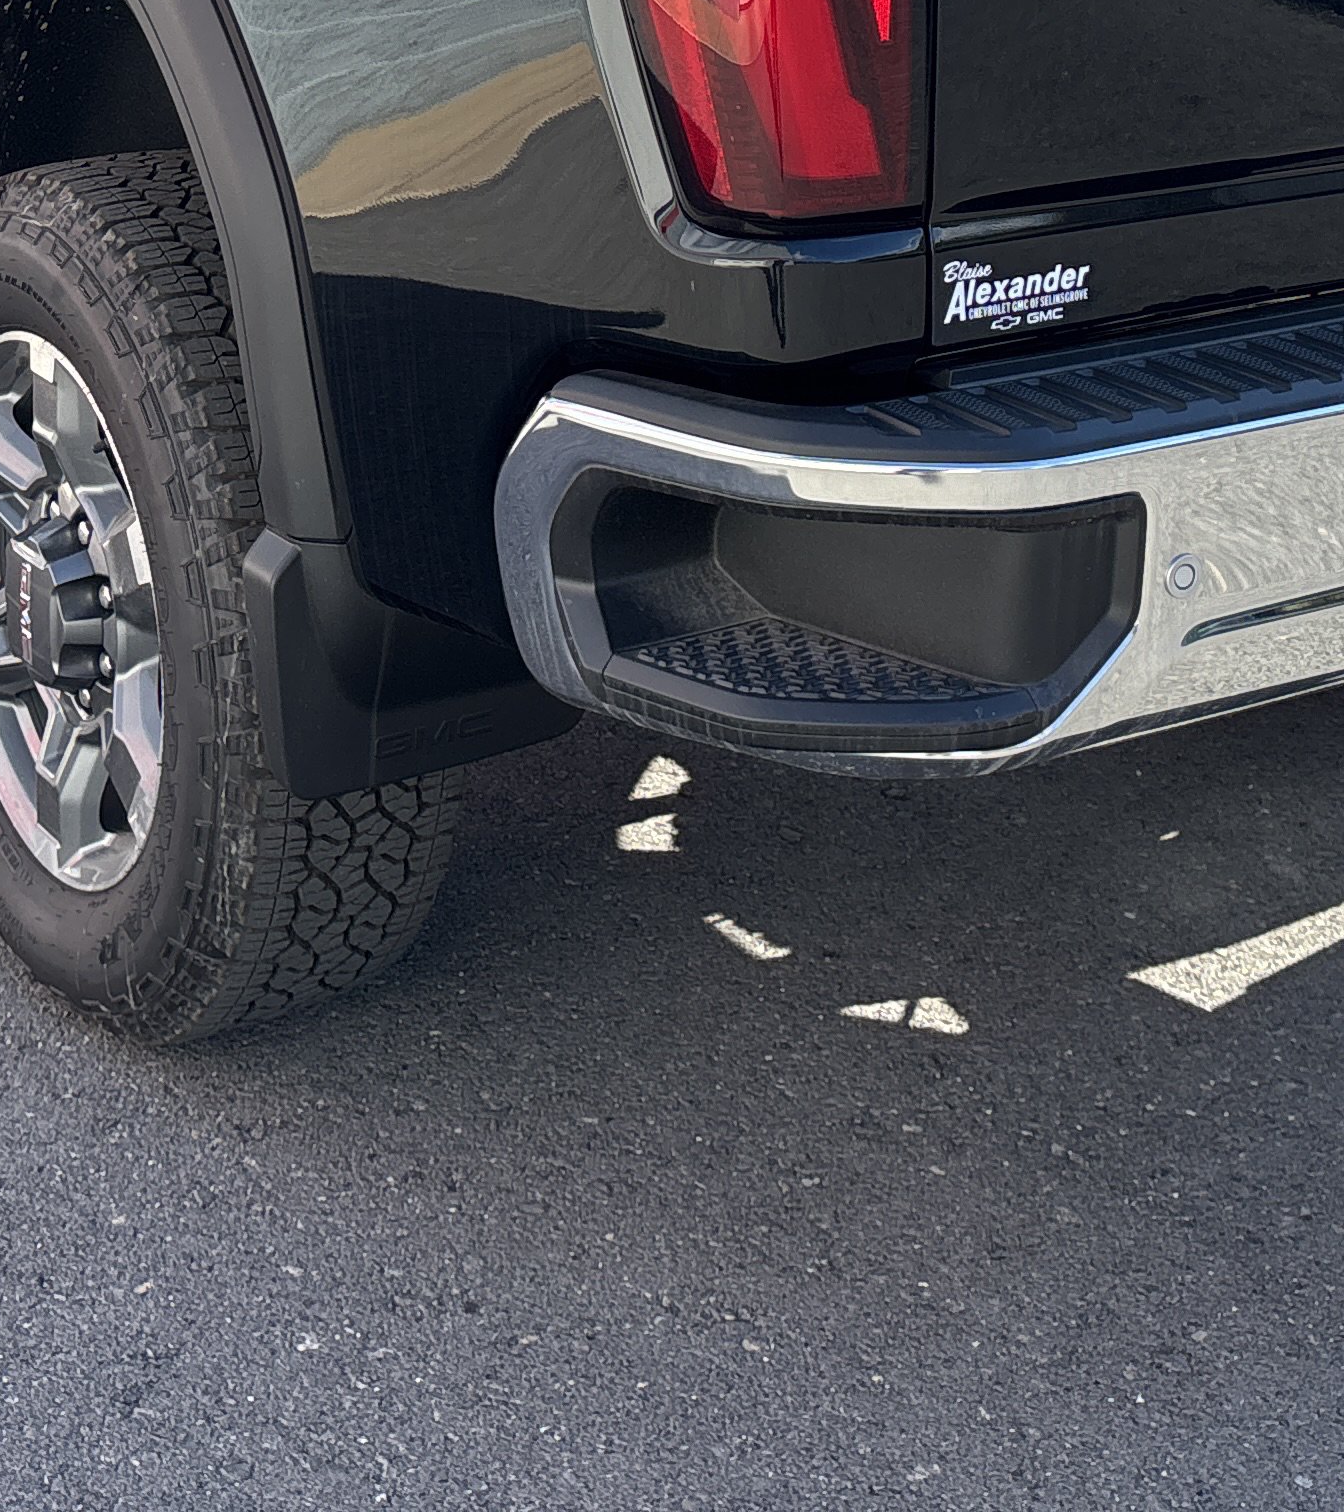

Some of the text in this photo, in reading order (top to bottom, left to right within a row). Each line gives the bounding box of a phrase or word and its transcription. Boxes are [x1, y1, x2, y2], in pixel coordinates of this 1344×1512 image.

[943, 261, 993, 283] Blaise
[943, 264, 1091, 324] Alexander
[968, 288, 1089, 320] CHEVROLET GMC OF SELINSGROVE
[1026, 307, 1064, 324] GMC
